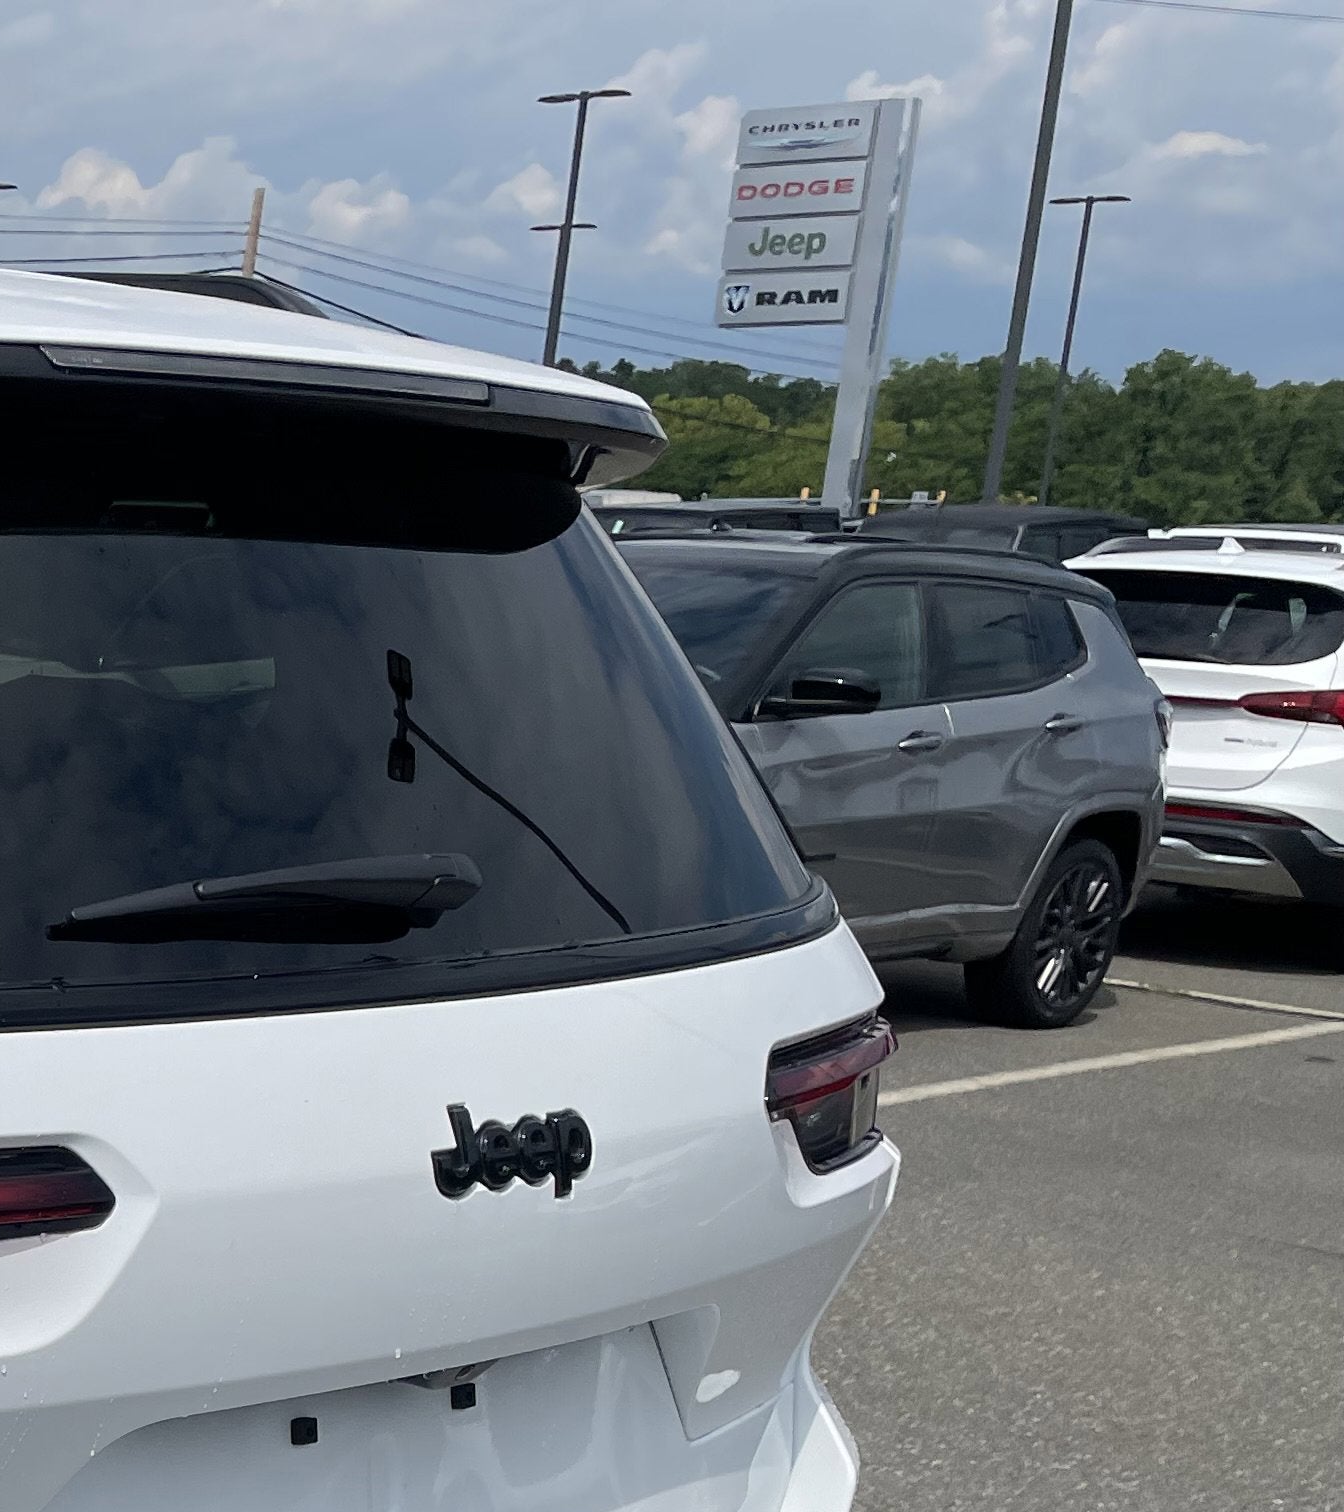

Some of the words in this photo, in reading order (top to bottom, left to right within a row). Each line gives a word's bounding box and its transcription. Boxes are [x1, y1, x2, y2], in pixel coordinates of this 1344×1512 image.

[748, 117, 861, 135] CHRYSLER
[736, 178, 855, 200] DODGE
[748, 226, 826, 260] Jeep
[755, 288, 839, 307] RAM
[430, 1101, 593, 1199] Jeep
